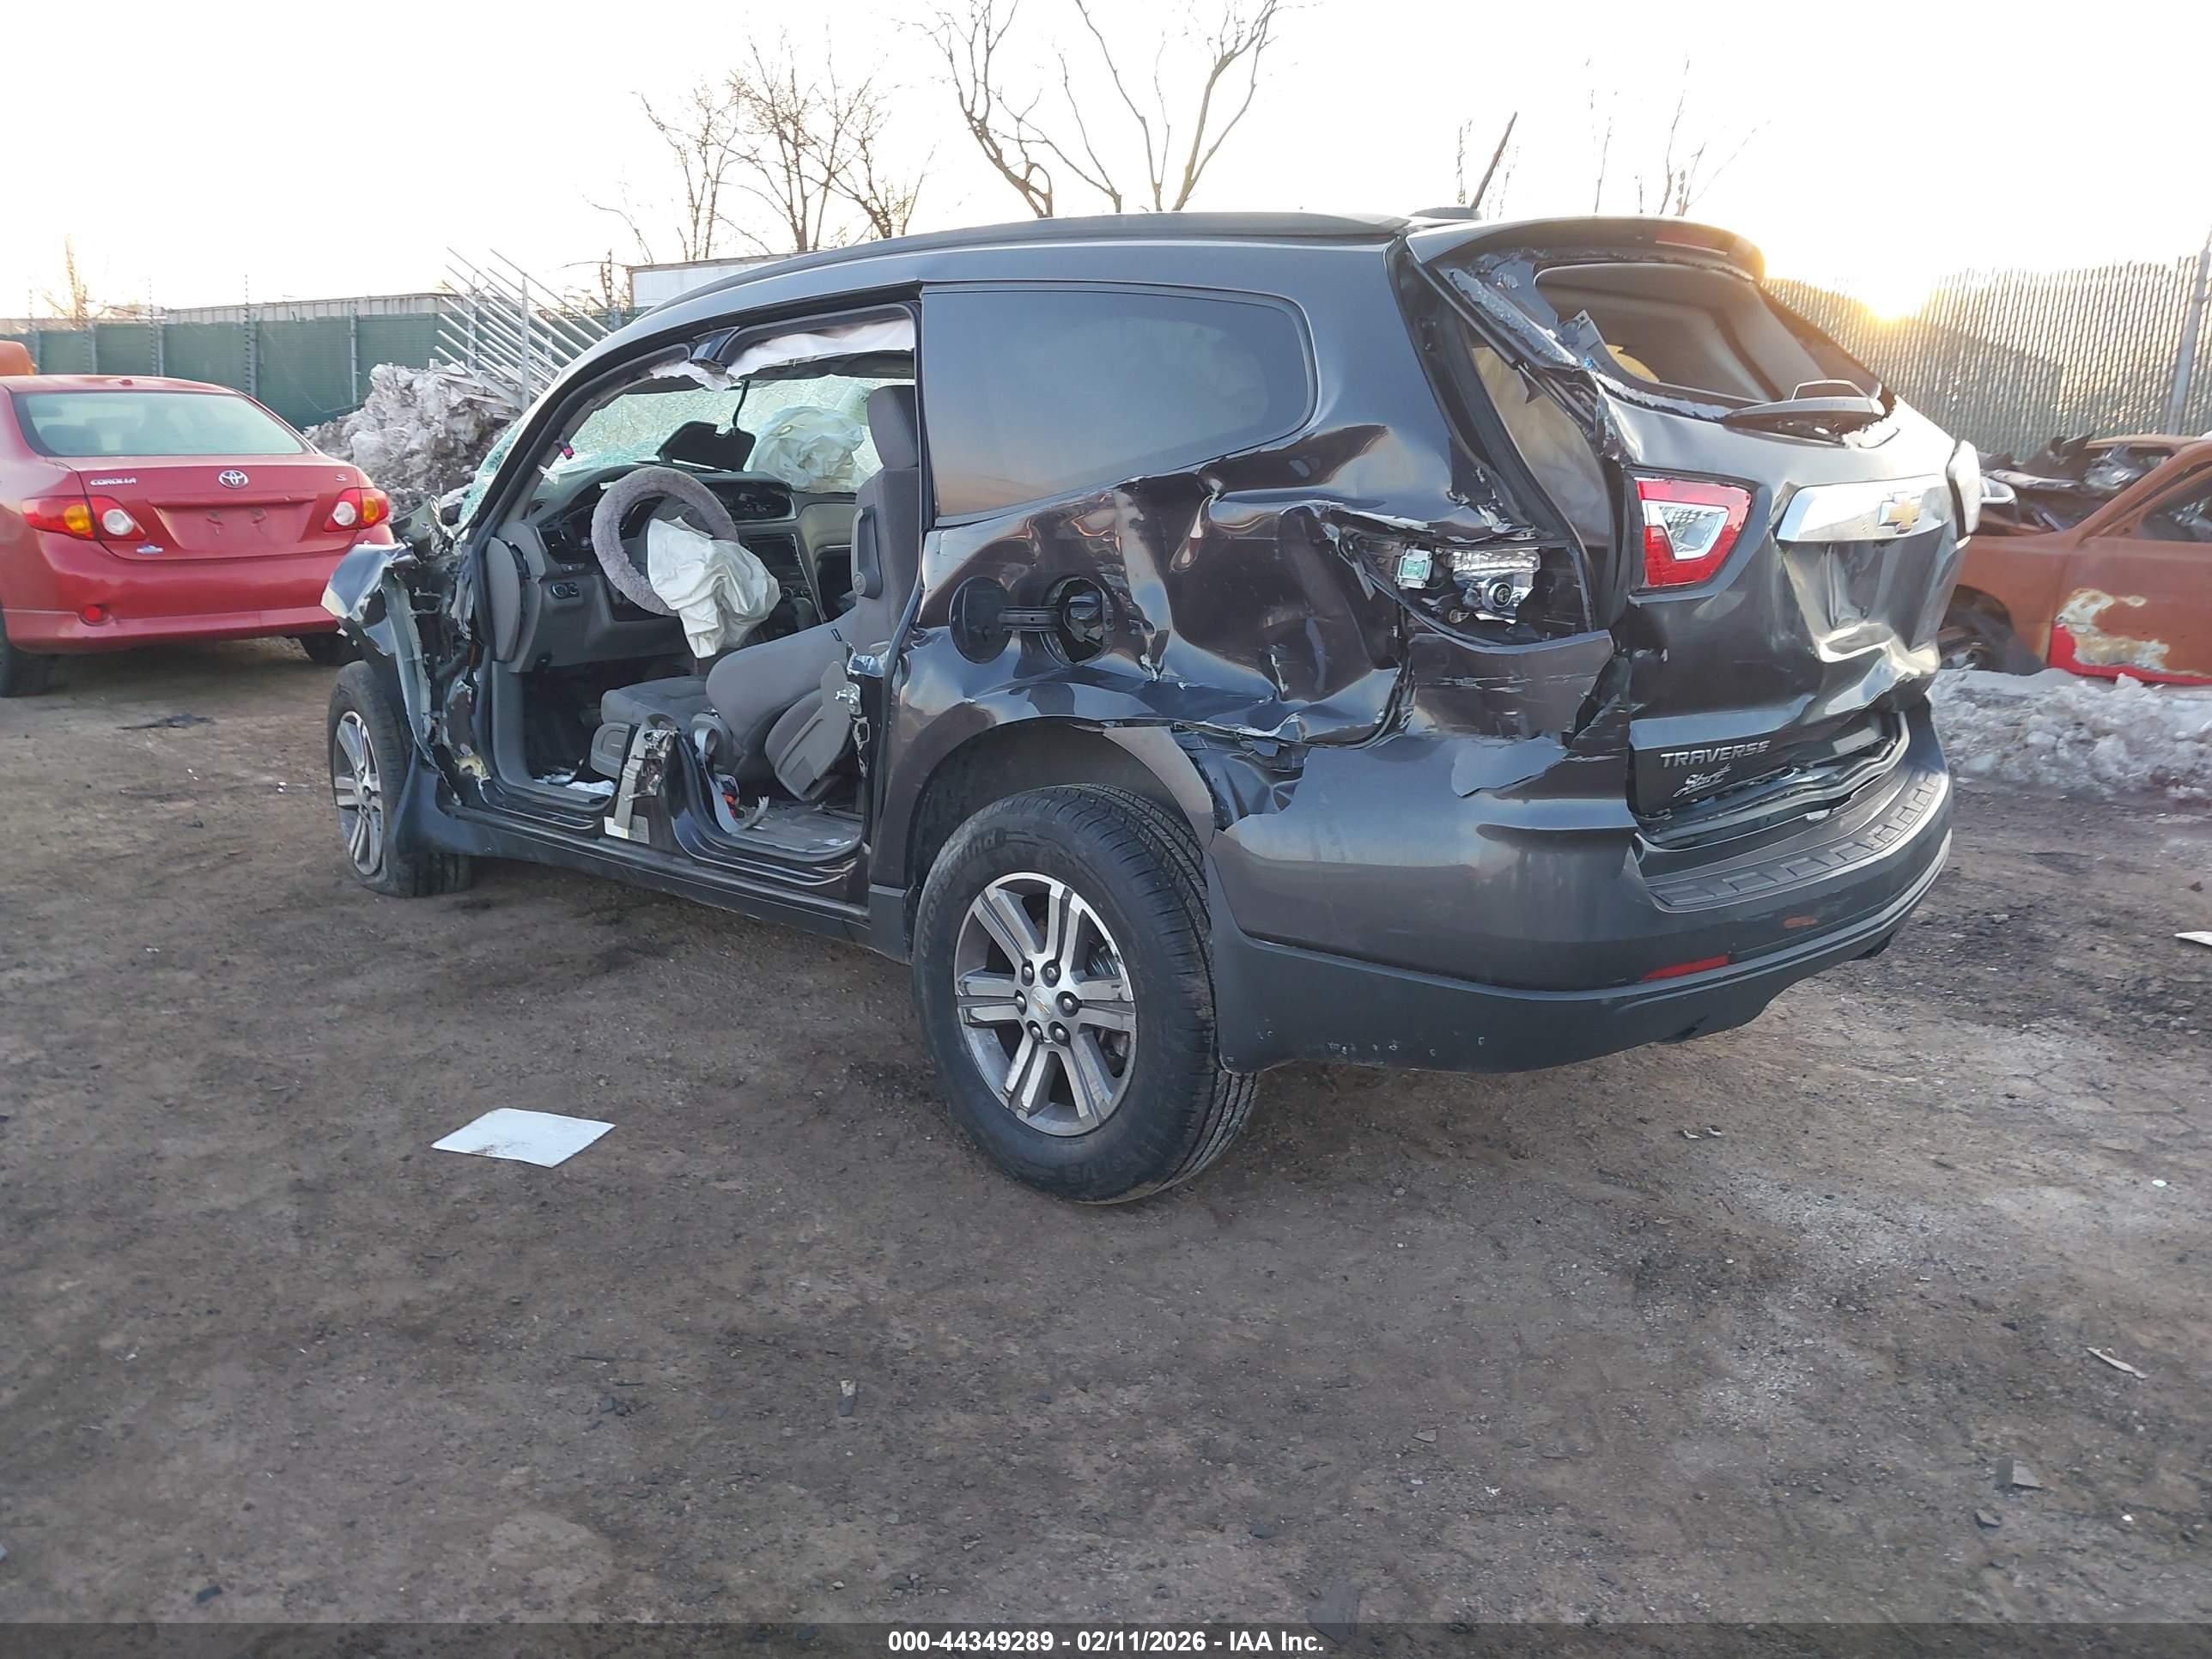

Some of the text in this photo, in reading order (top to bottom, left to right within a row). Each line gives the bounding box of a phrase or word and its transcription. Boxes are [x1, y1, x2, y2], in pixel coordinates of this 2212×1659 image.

[89, 477, 137, 487] COROLLA
[336, 473, 348, 482] S
[1660, 740, 1771, 769] TRAVERSE
